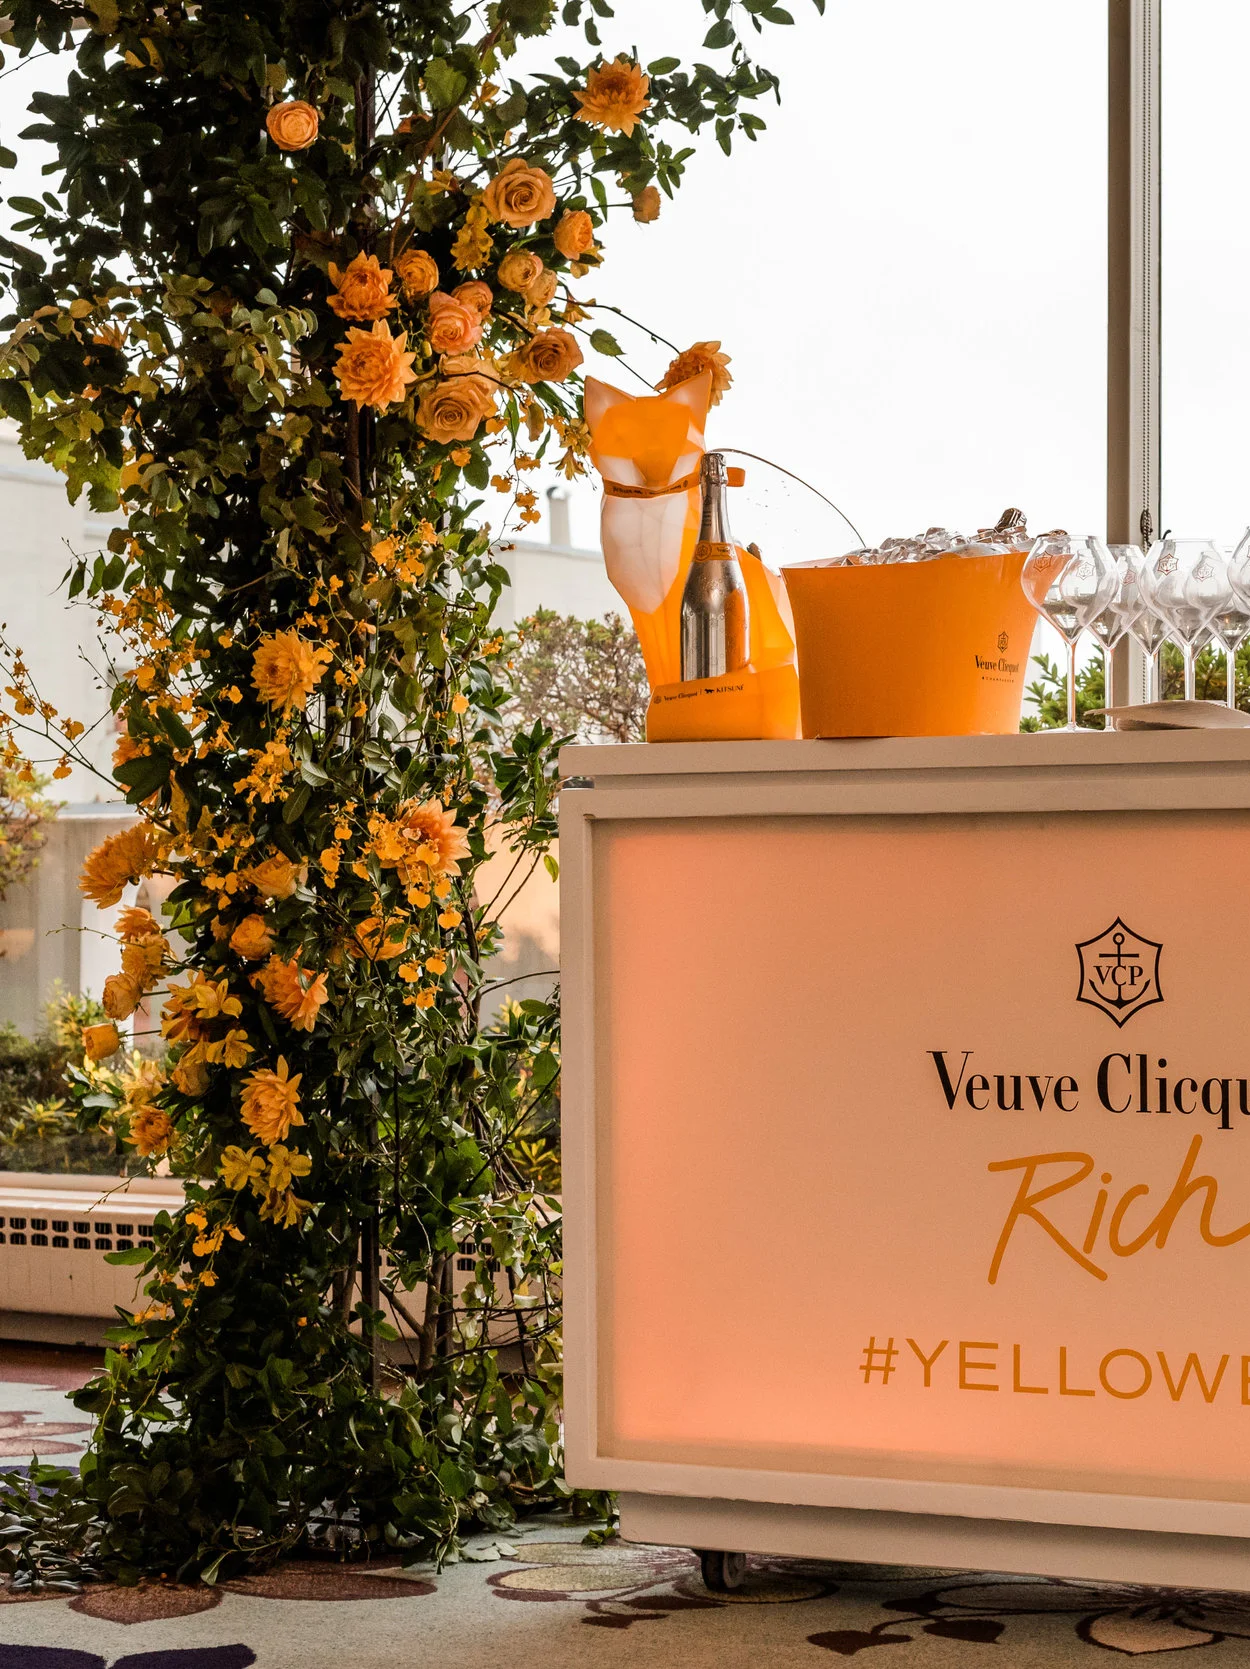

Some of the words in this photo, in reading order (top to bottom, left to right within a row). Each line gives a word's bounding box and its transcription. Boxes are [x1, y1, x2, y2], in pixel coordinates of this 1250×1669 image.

[975, 655, 997, 670] Veuve
[1093, 965, 1144, 986] VCP
[926, 1050, 1080, 1112] Veuve
